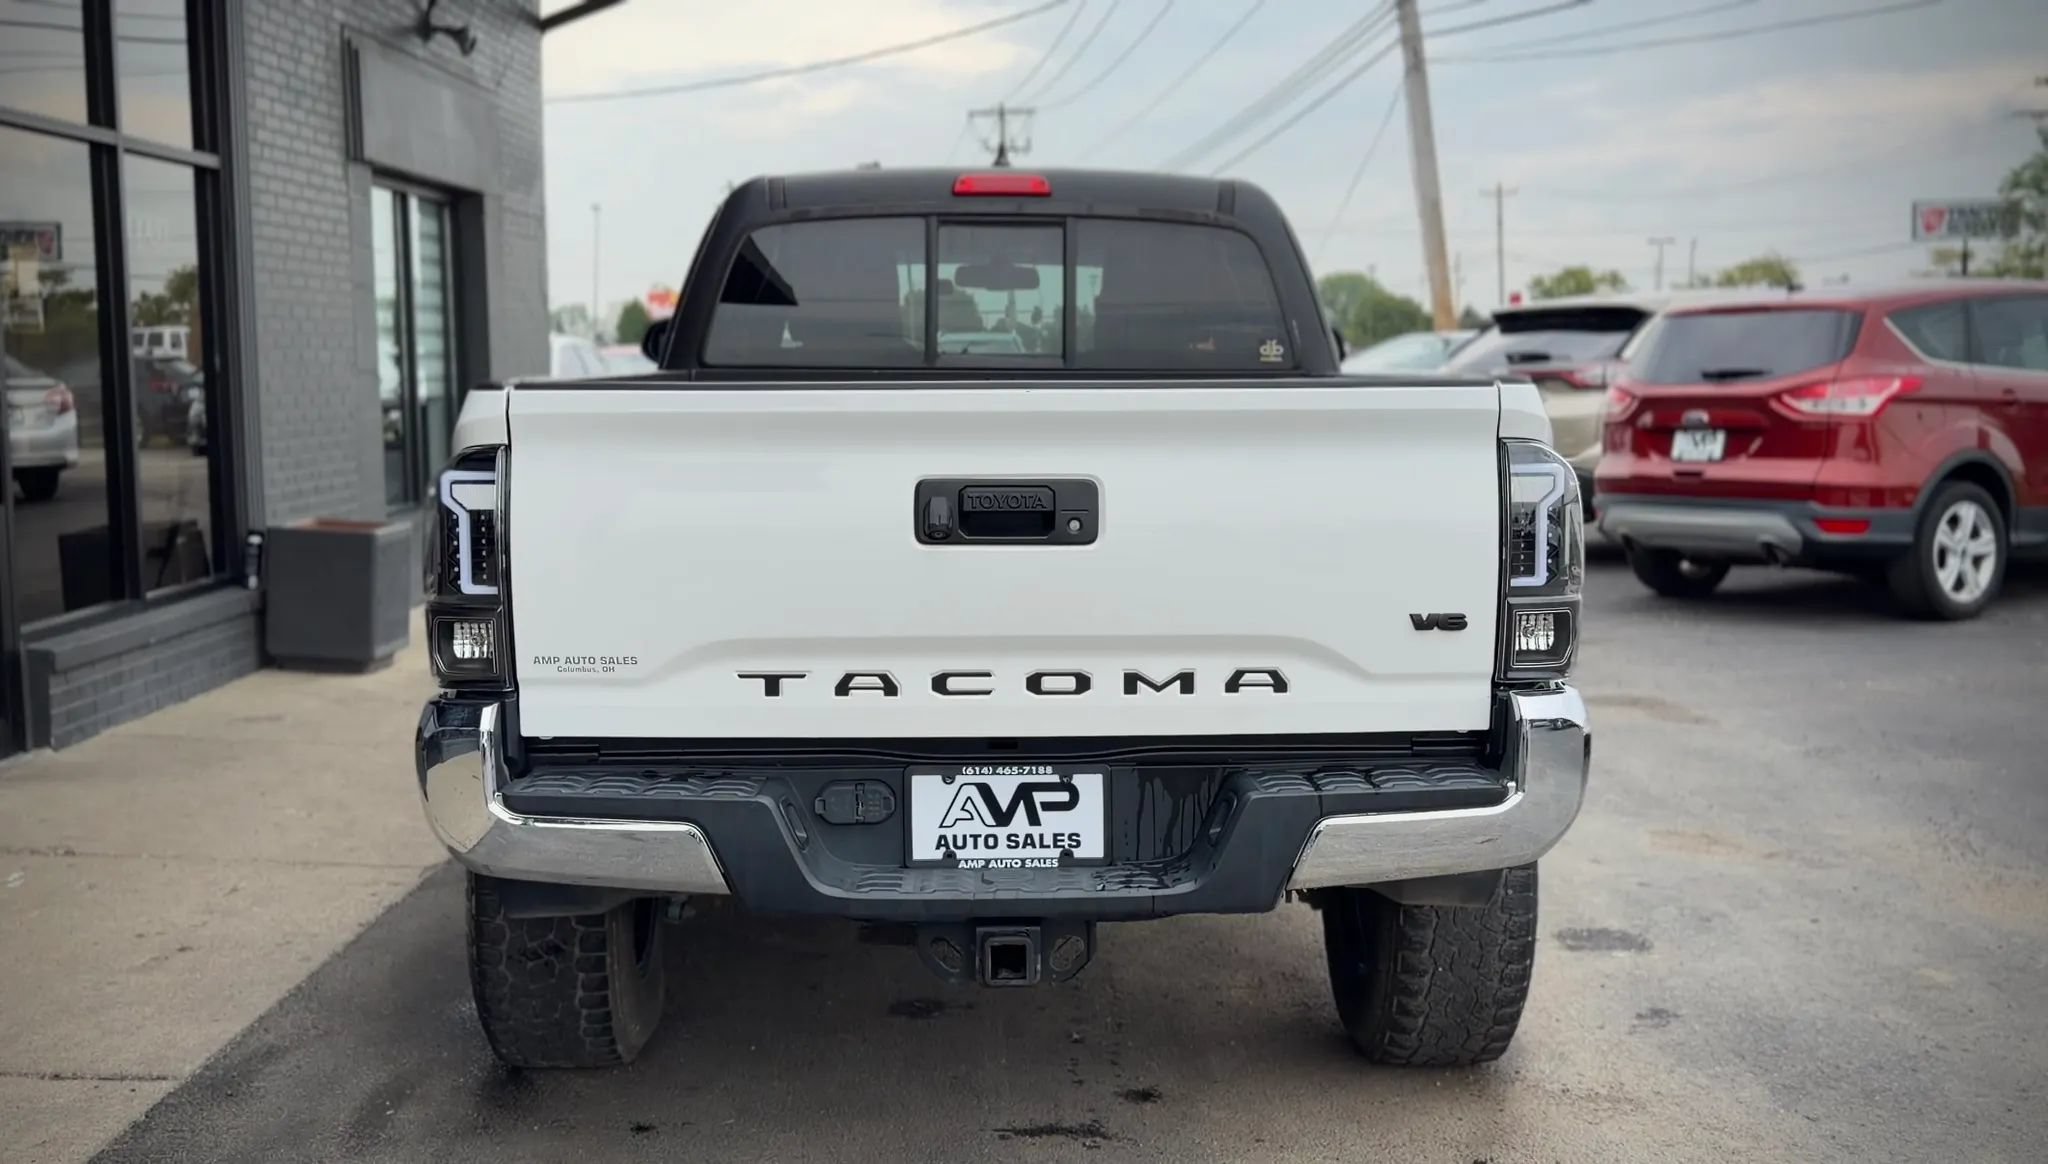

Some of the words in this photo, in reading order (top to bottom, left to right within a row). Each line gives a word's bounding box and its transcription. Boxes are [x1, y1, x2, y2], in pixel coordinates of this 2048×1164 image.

[967, 494, 1047, 510] TOYOTA
[1409, 612, 1468, 631] V6
[533, 656, 560, 665] AMP
[564, 656, 596, 665] AUTO
[600, 656, 638, 665] SALES
[557, 665, 600, 673] Columbus,
[602, 665, 615, 673] OH
[736, 668, 1290, 697] TACOMA
[962, 766, 993, 775] (614)
[996, 766, 1053, 775] 465-7188
[938, 782, 1080, 828] AMP
[935, 834, 999, 850] AUTO
[1006, 833, 1081, 849] SALES
[958, 859, 985, 869] AMP
[988, 859, 1022, 868] AUTO
[1025, 858, 1059, 868] SALES
